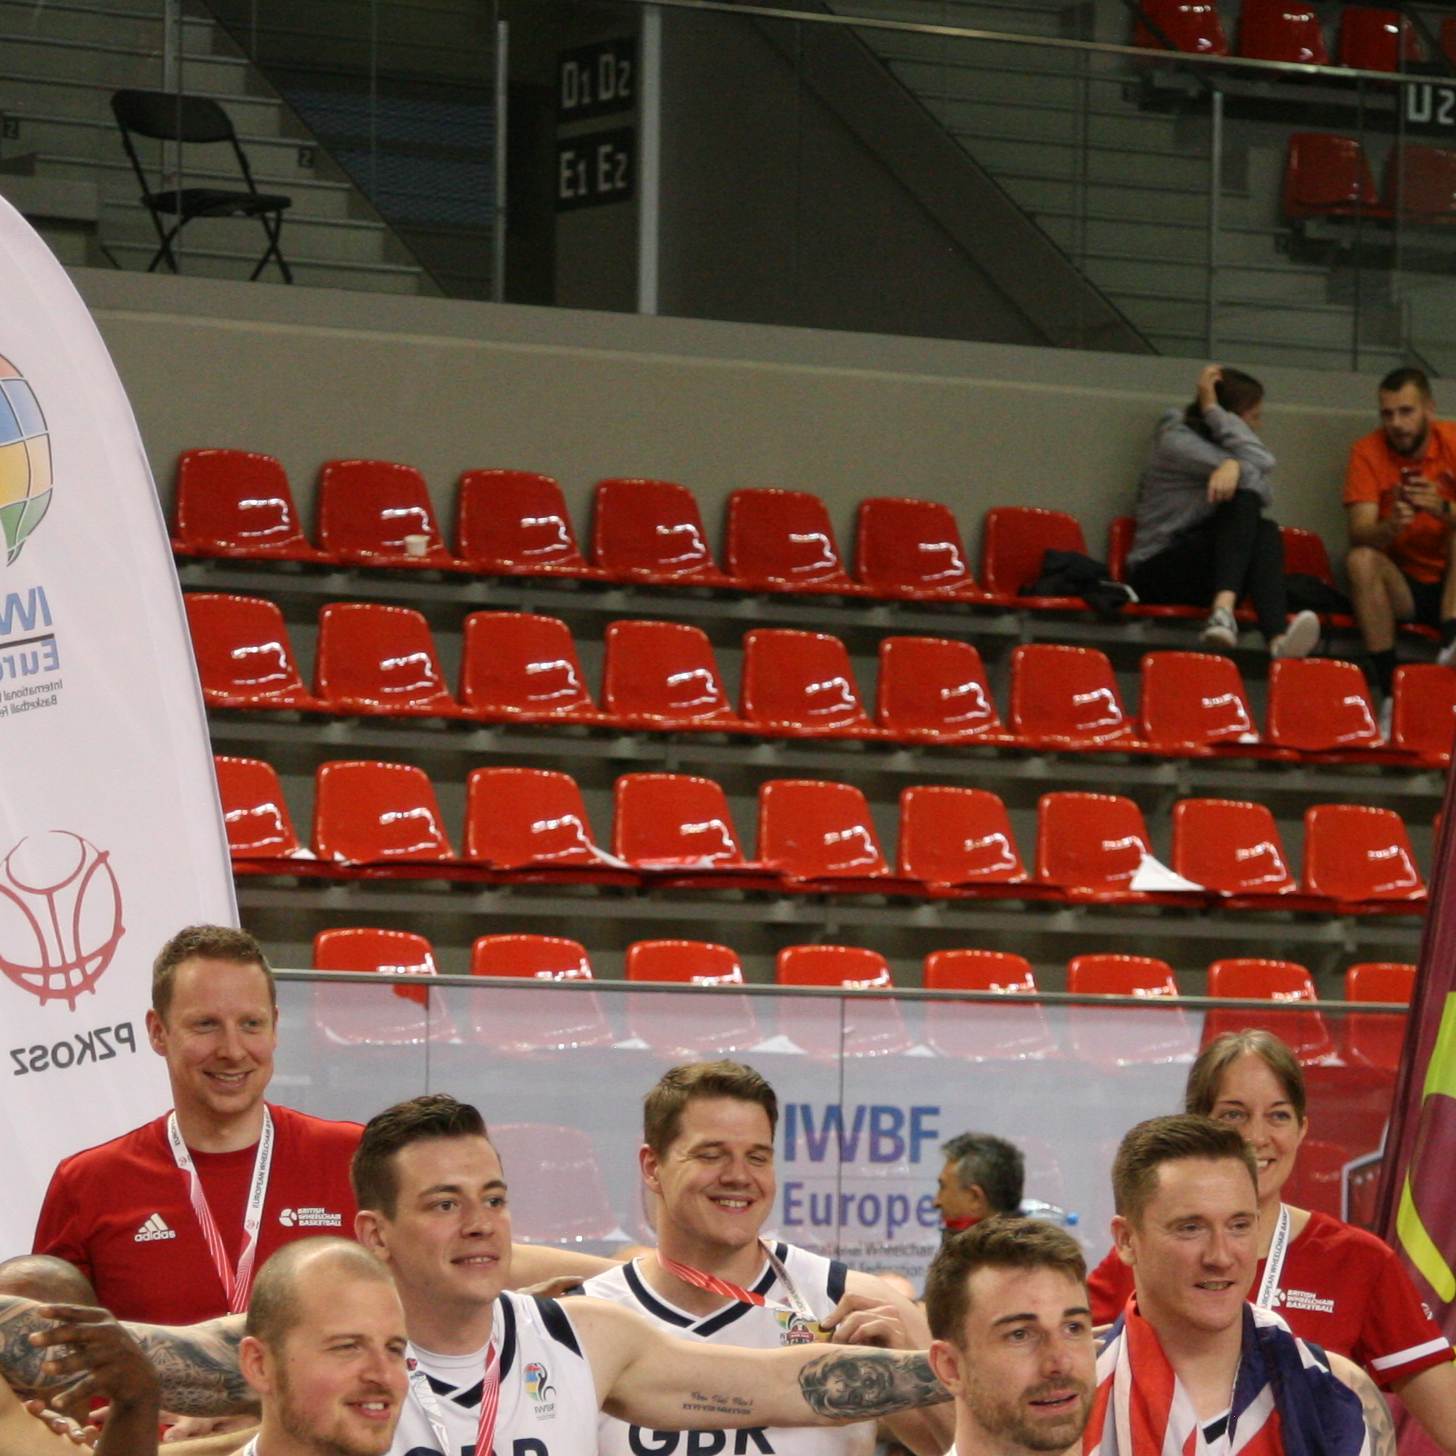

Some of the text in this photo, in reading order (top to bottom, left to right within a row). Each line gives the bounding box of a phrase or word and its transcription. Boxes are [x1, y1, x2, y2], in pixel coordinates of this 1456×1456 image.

[784, 1103, 941, 1164] IWBF
[299, 1219, 343, 1227] BASKETBALL
[783, 1181, 941, 1240] Europe
[134, 1230, 177, 1242] adidas
